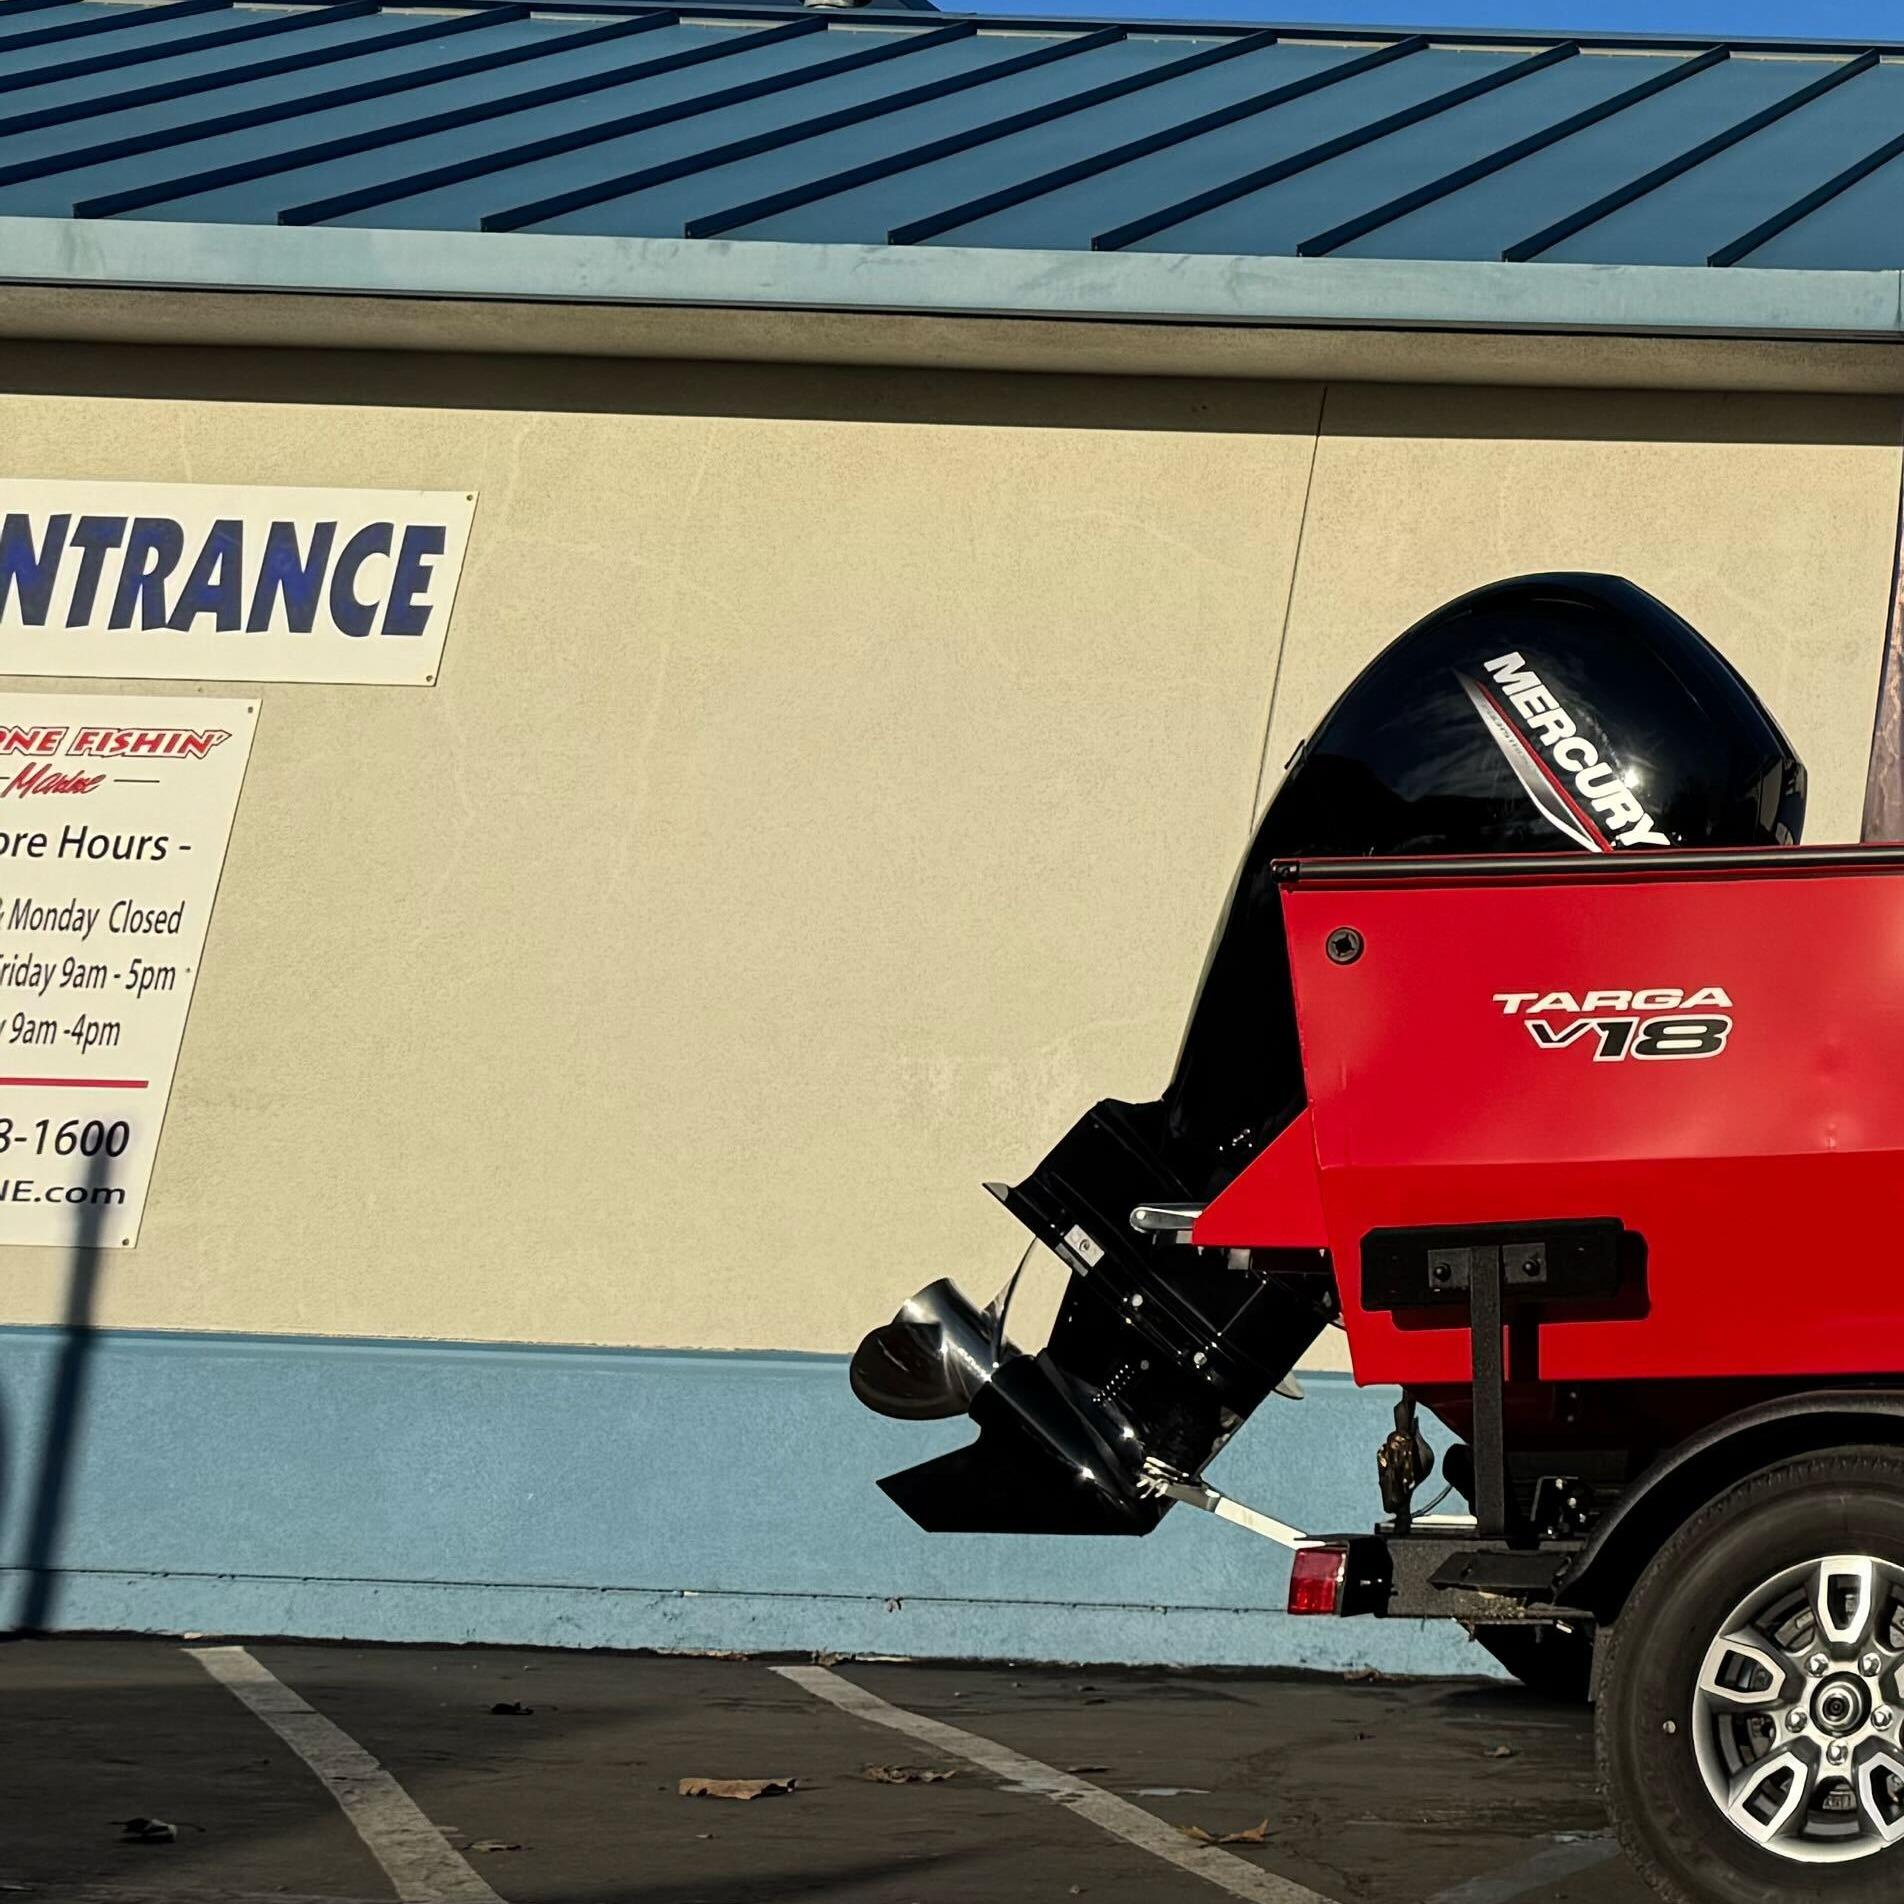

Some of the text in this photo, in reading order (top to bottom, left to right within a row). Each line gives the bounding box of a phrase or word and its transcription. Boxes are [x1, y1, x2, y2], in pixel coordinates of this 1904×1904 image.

[1483, 651, 1671, 846] MERCURY
[57, 825, 169, 860] Hours
[8, 898, 100, 942] Monday
[109, 899, 185, 934] Closed
[0, 953, 56, 997] riday
[60, 956, 107, 989] 9am
[126, 958, 176, 999] 5pm
[1493, 987, 1733, 1014] TARGA
[9, 1012, 57, 1045] 9am
[1524, 1014, 1733, 1062] V18
